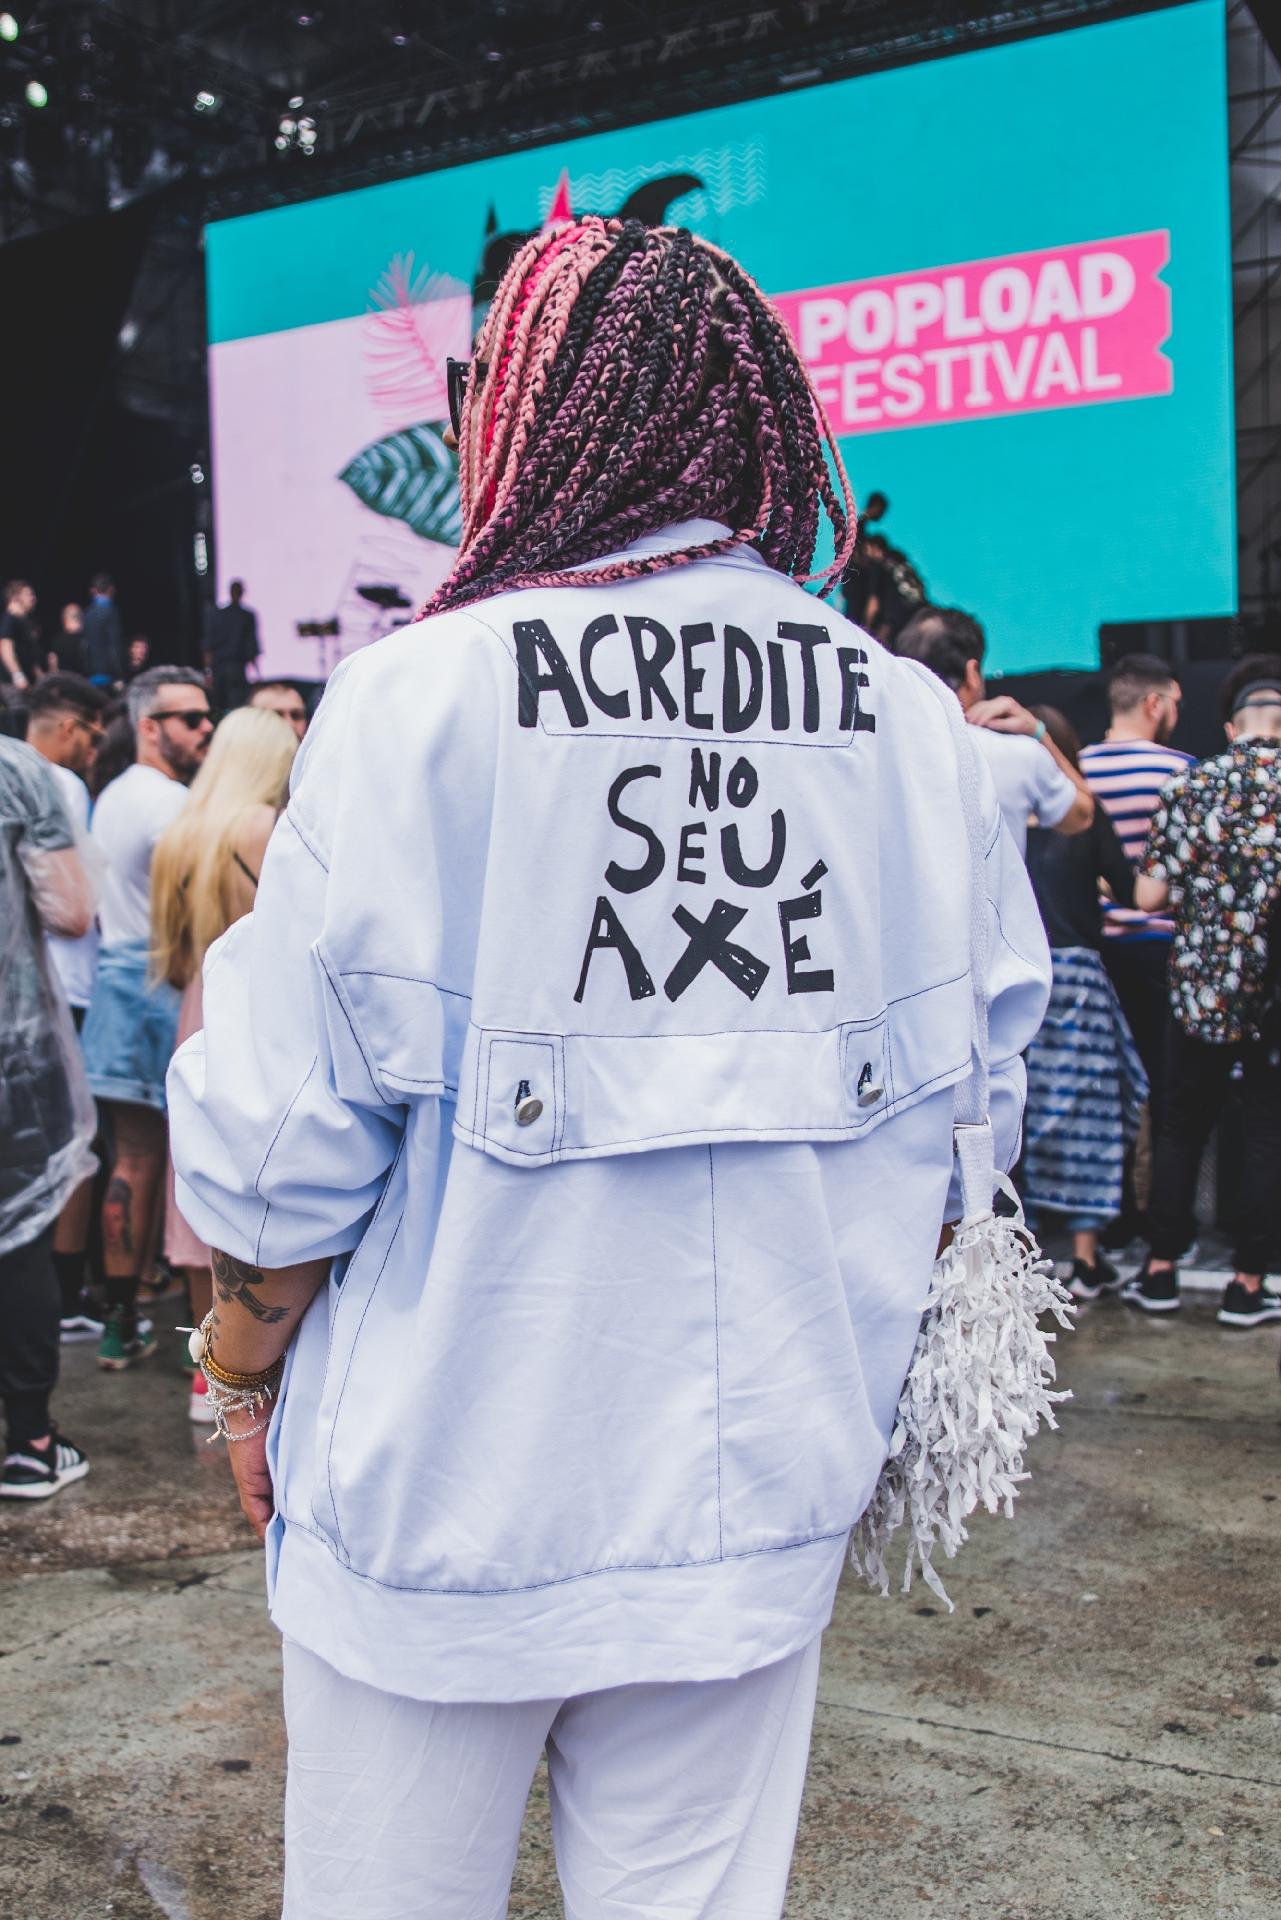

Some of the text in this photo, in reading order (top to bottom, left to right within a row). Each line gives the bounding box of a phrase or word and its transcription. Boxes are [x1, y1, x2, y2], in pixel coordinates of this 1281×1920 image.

[799, 252, 1136, 359] POPLOAD
[810, 328, 1122, 424] FESTIVAL
[513, 614, 875, 733] ACREDITE
[605, 765, 786, 894] SEU
[688, 747, 759, 812] NO
[574, 859, 834, 1003] AXÉ
